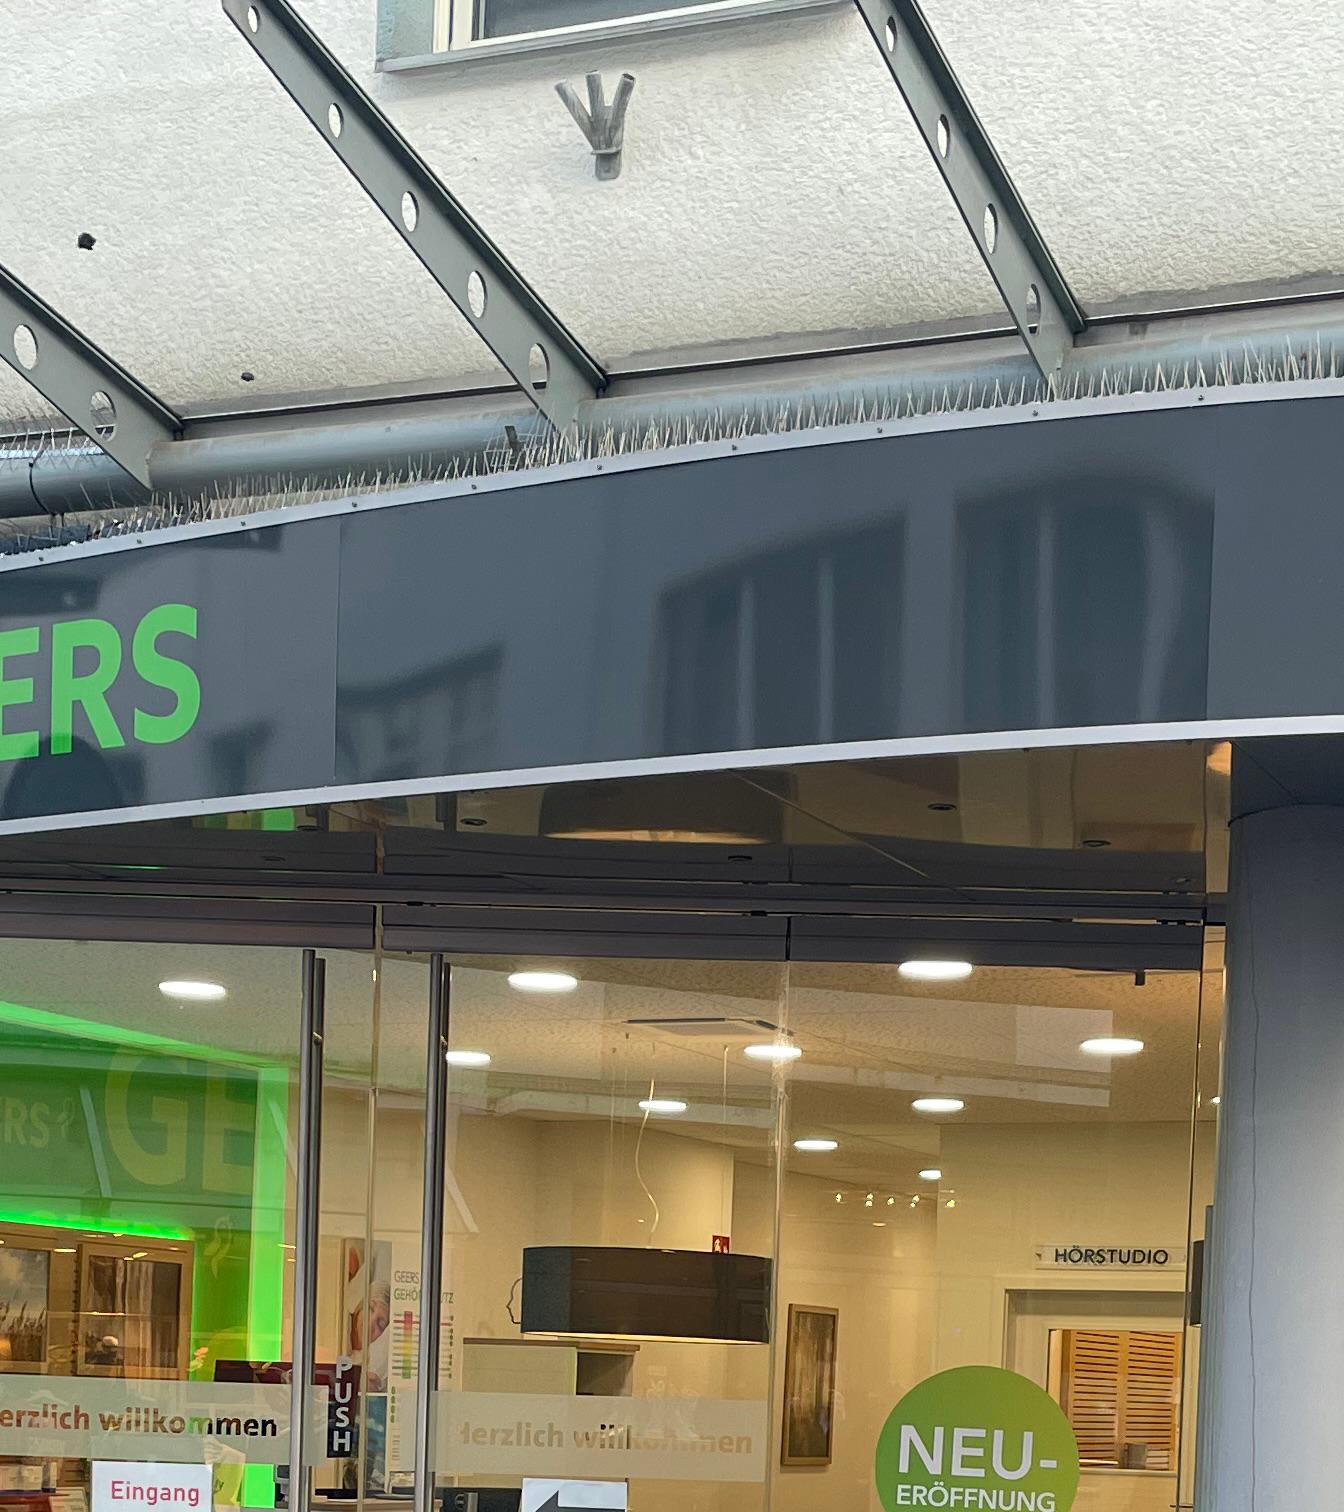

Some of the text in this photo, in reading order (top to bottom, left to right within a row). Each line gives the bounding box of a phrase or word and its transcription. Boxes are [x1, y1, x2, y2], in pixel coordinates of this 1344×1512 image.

[1054, 1244, 1170, 1267] HÖRSTUDIO
[393, 1269, 420, 1286] GEERS
[332, 1355, 354, 1454] PUSH
[98, 1406, 278, 1438] willkommen
[897, 1424, 1058, 1481] NEU-
[110, 1479, 201, 1508] Eingang
